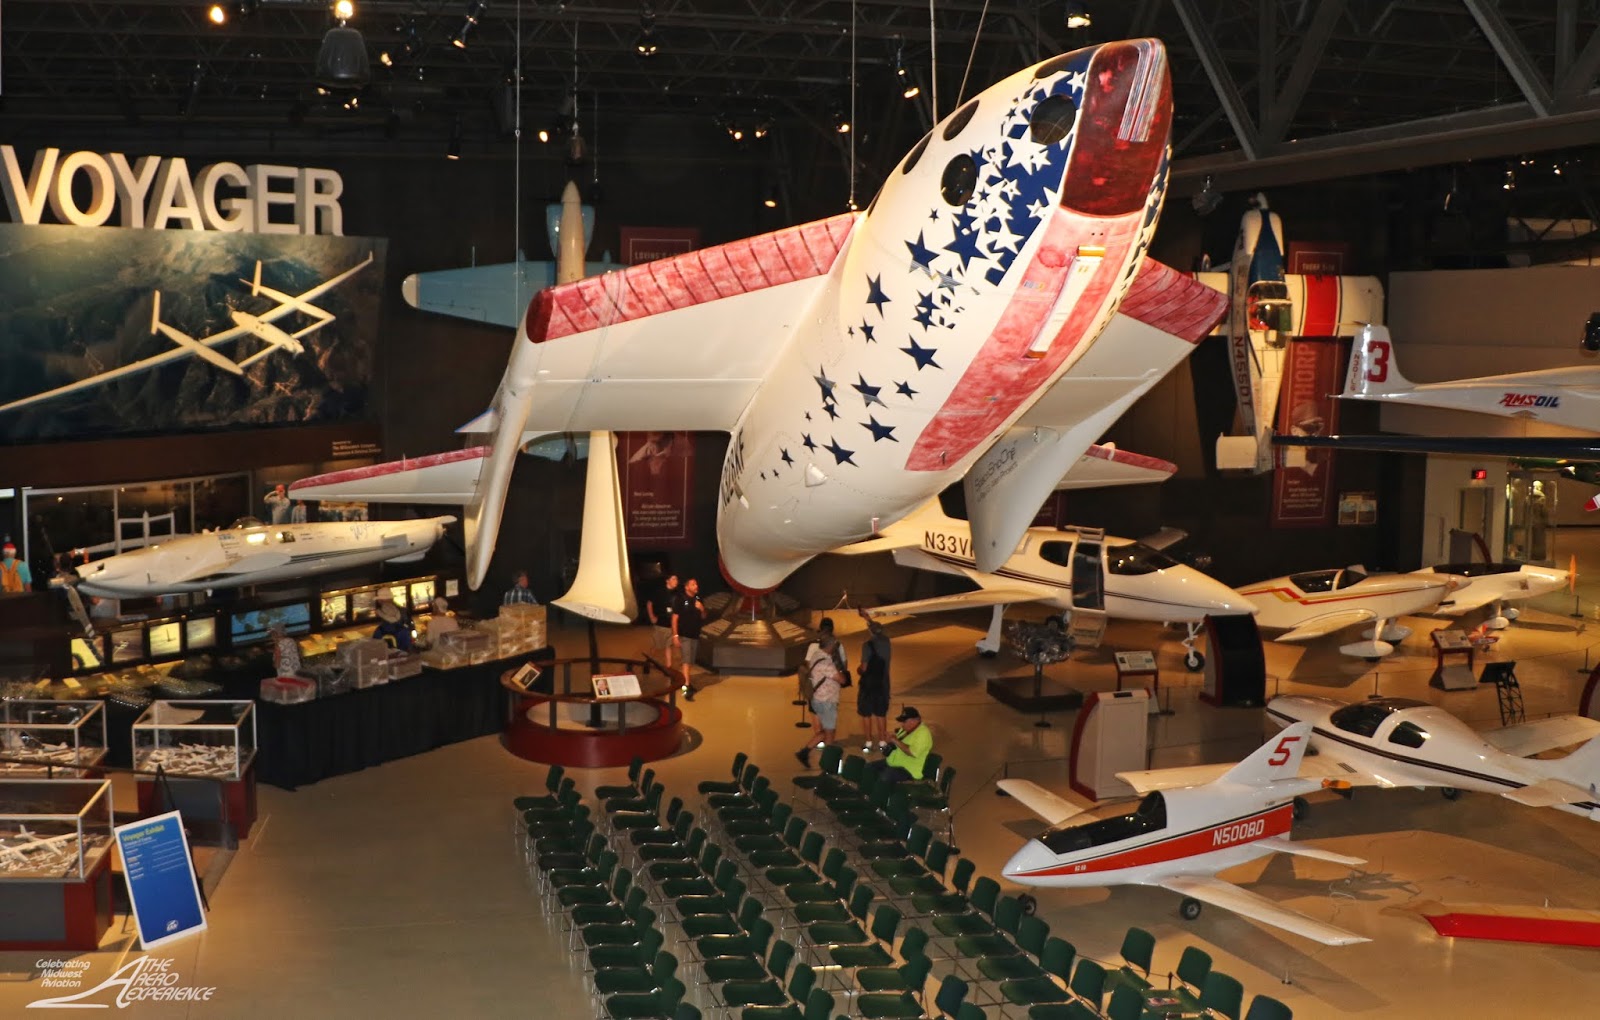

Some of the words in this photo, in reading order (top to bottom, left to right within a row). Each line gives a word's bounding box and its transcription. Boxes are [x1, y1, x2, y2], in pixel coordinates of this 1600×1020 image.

[0, 145, 344, 236] VOYAGER
[1367, 341, 1391, 383] 3
[1499, 393, 1560, 408] AMSOIL
[925, 530, 973, 557] N33V
[1268, 736, 1300, 766] 5
[1212, 819, 1265, 846] N500BD
